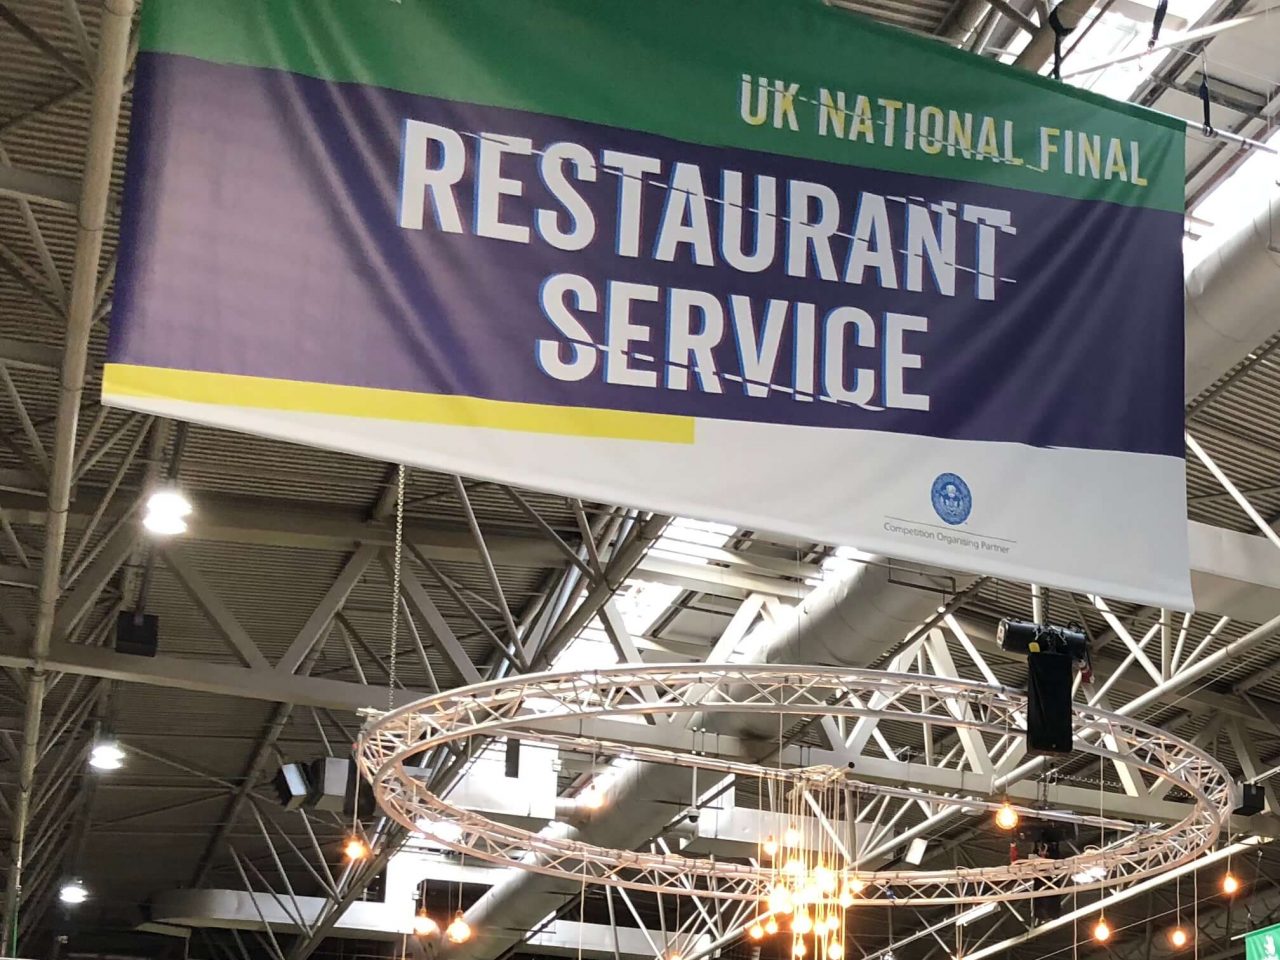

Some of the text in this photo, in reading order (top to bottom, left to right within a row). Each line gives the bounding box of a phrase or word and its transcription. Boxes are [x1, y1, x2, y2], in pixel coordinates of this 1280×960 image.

[740, 74, 1148, 187] UK NATIONAL FINAL
[398, 118, 1018, 301] RESTAURANT
[536, 272, 931, 412] SERVICE
[883, 523, 1010, 554] Competition Organising Partner
